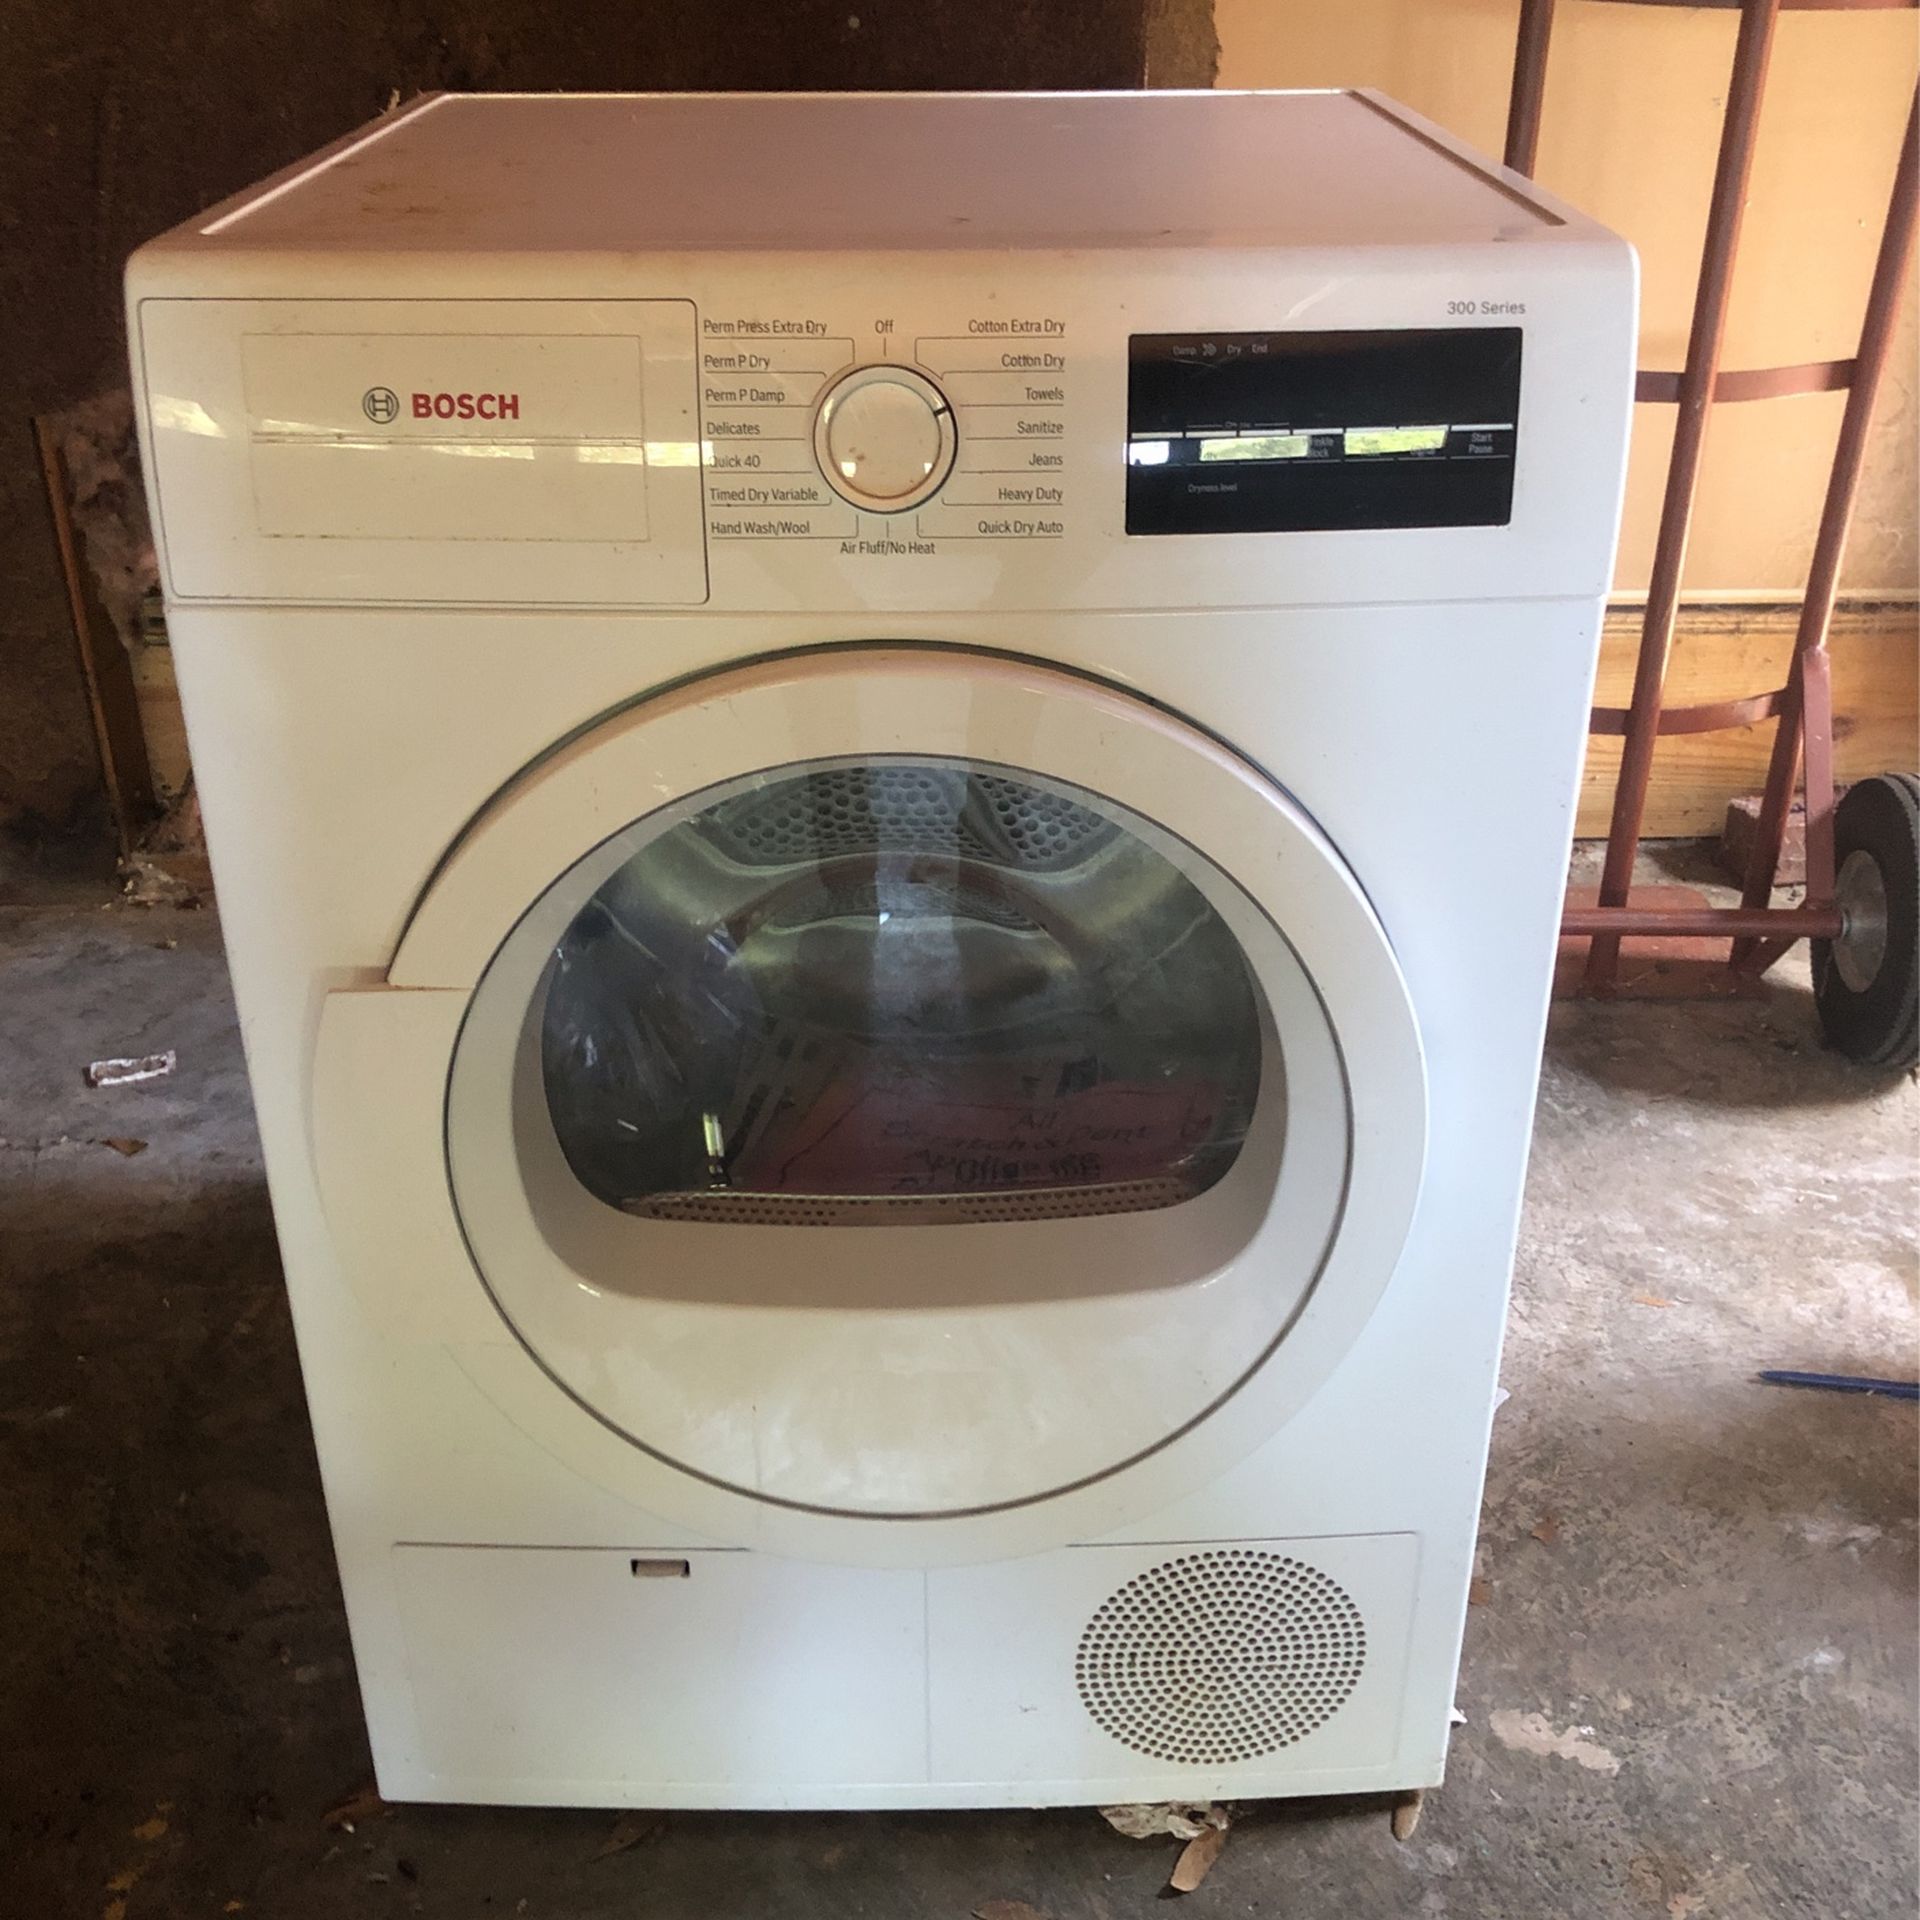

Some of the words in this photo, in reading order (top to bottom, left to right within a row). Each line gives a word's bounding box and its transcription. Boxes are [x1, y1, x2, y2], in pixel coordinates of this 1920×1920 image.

[1447, 301, 1476, 315] 300
[1480, 301, 1526, 315] Series
[704, 320, 734, 333] Perm
[738, 320, 770, 333] Press
[773, 320, 803, 333] Extra
[806, 320, 827, 335] Dry
[875, 320, 894, 334] Off
[969, 320, 1008, 333] Cotton
[1011, 320, 1041, 333] Extra
[1044, 320, 1065, 335] Dry
[704, 355, 736, 368] Perm
[739, 355, 746, 367] P
[749, 355, 770, 369] Dry
[1002, 354, 1041, 366] Cotton
[1044, 354, 1065, 369] Dry
[706, 389, 737, 402] Perm
[740, 389, 747, 401] P
[750, 389, 785, 403] Damp
[1026, 388, 1064, 400] Towels
[412, 393, 520, 419] BOSCH
[707, 423, 760, 435] Delicates
[1018, 421, 1063, 433] Sanitize
[1471, 432, 1493, 443] Start
[744, 454, 761, 468] 40
[1029, 454, 1063, 466] Jeans
[710, 488, 745, 501] Timed
[748, 488, 768, 503] Dry
[771, 488, 818, 501] Variable
[999, 488, 1033, 502] Heavy
[1036, 488, 1062, 502] Duty
[712, 521, 742, 533] Hand
[744, 521, 810, 535] Wash/Wool
[978, 520, 1011, 533] Quick
[1014, 521, 1036, 535] Dry
[1038, 521, 1063, 533] Auto
[840, 541, 857, 554] Air
[859, 541, 907, 555] Fluff/No
[908, 541, 935, 554] Heat
